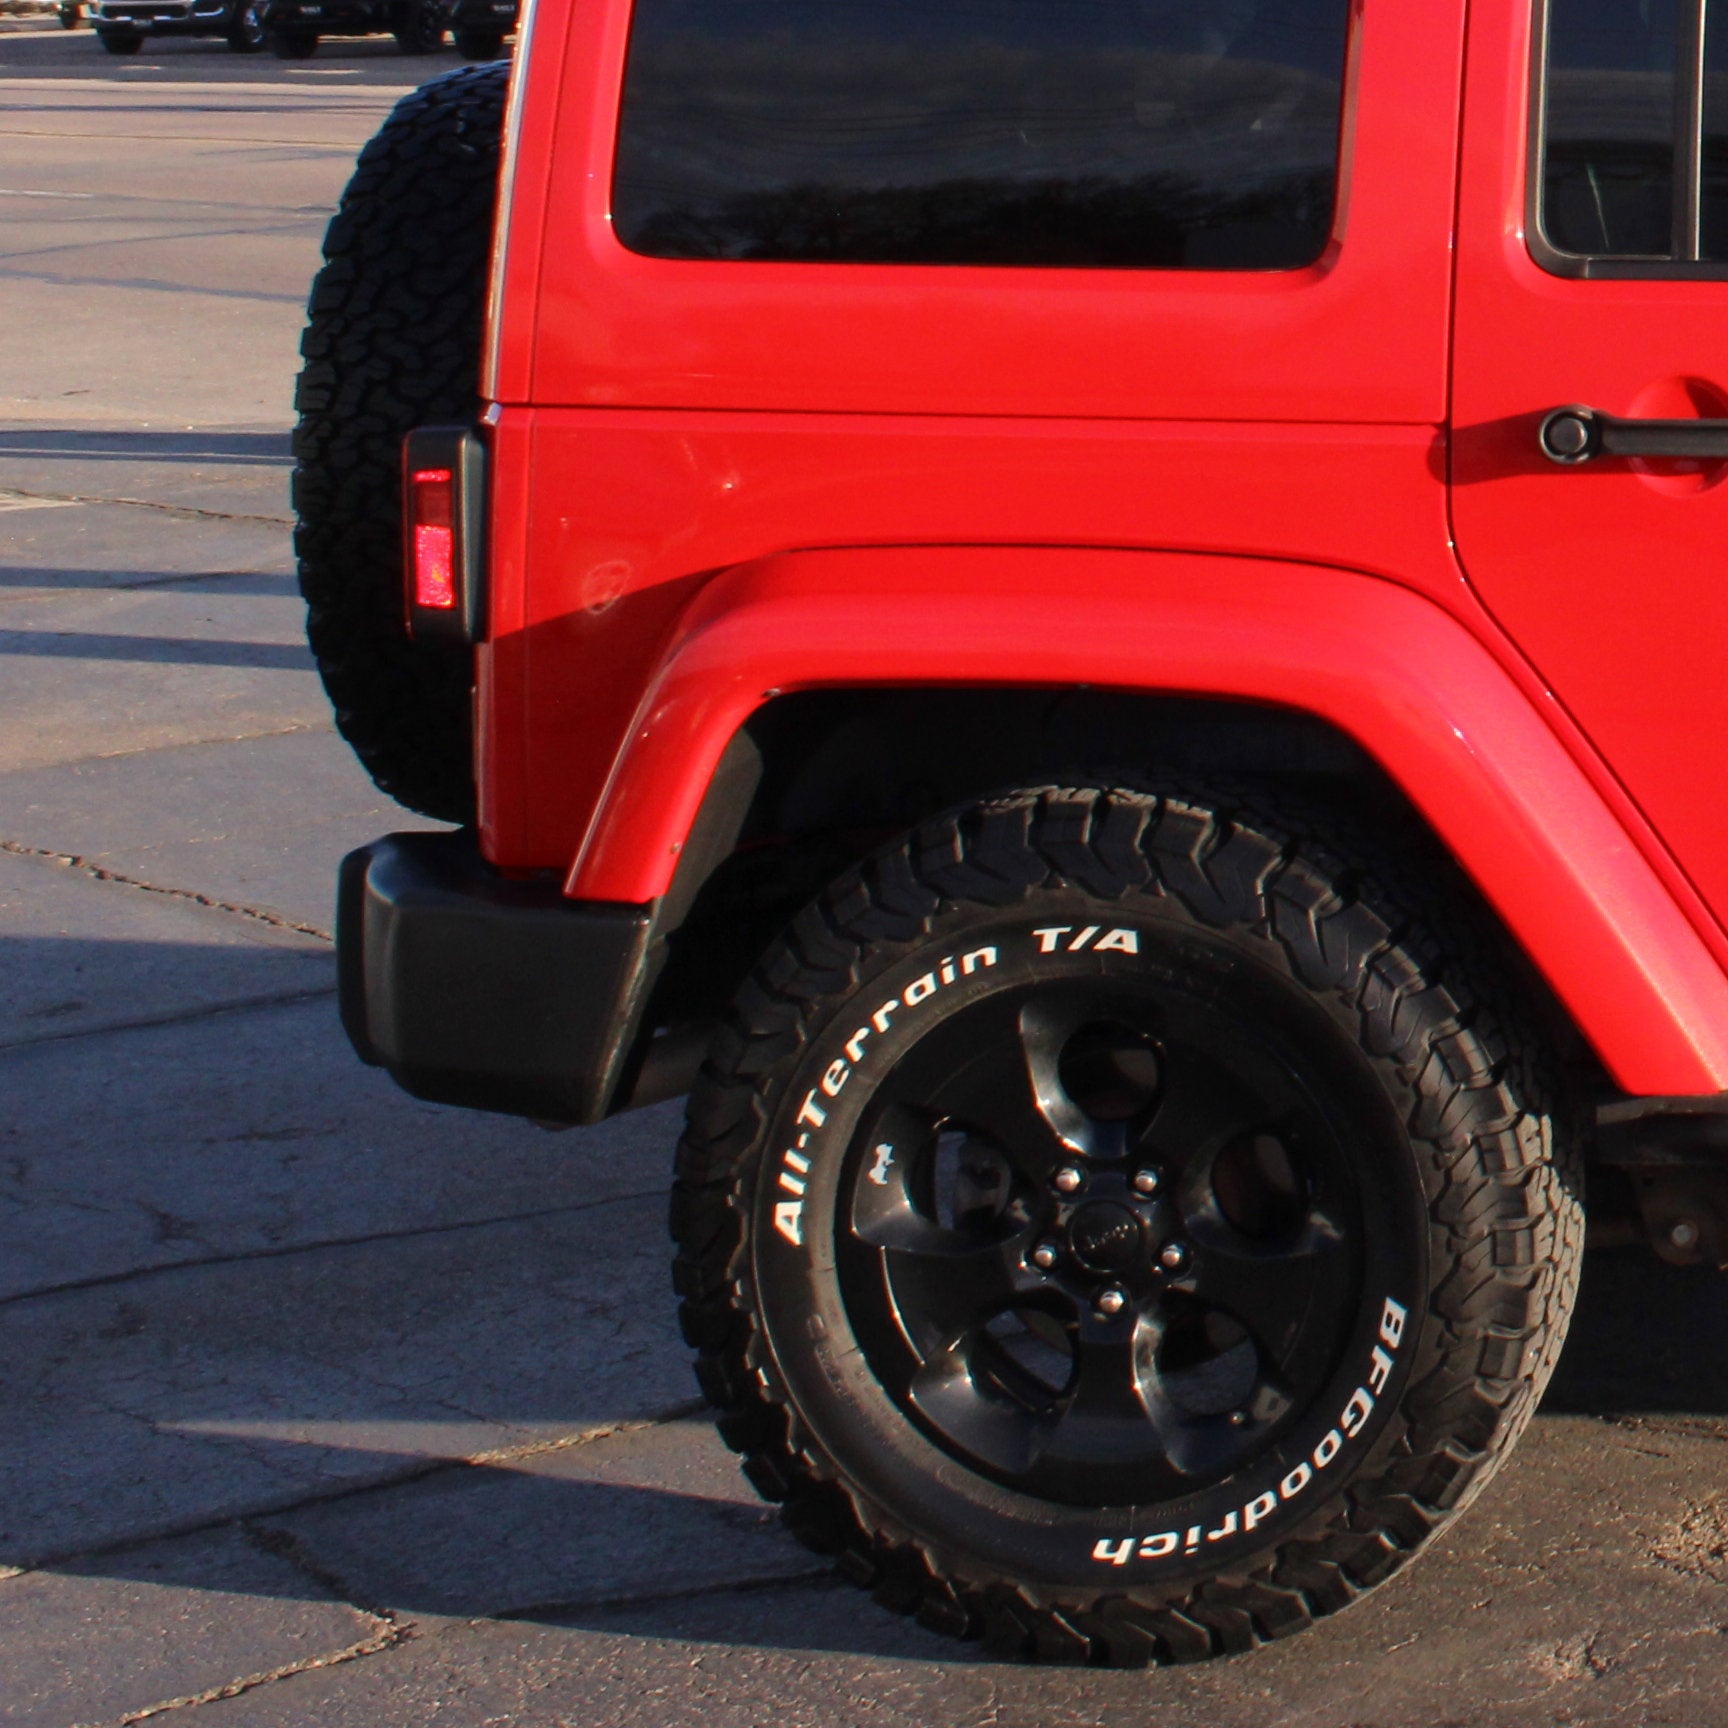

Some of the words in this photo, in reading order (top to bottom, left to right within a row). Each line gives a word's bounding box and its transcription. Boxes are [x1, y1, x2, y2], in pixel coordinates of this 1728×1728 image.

[774, 945, 998, 1247] All-Terrain
[1031, 925, 1140, 955] T/A
[1091, 1296, 1408, 1566] BFGoodrich
